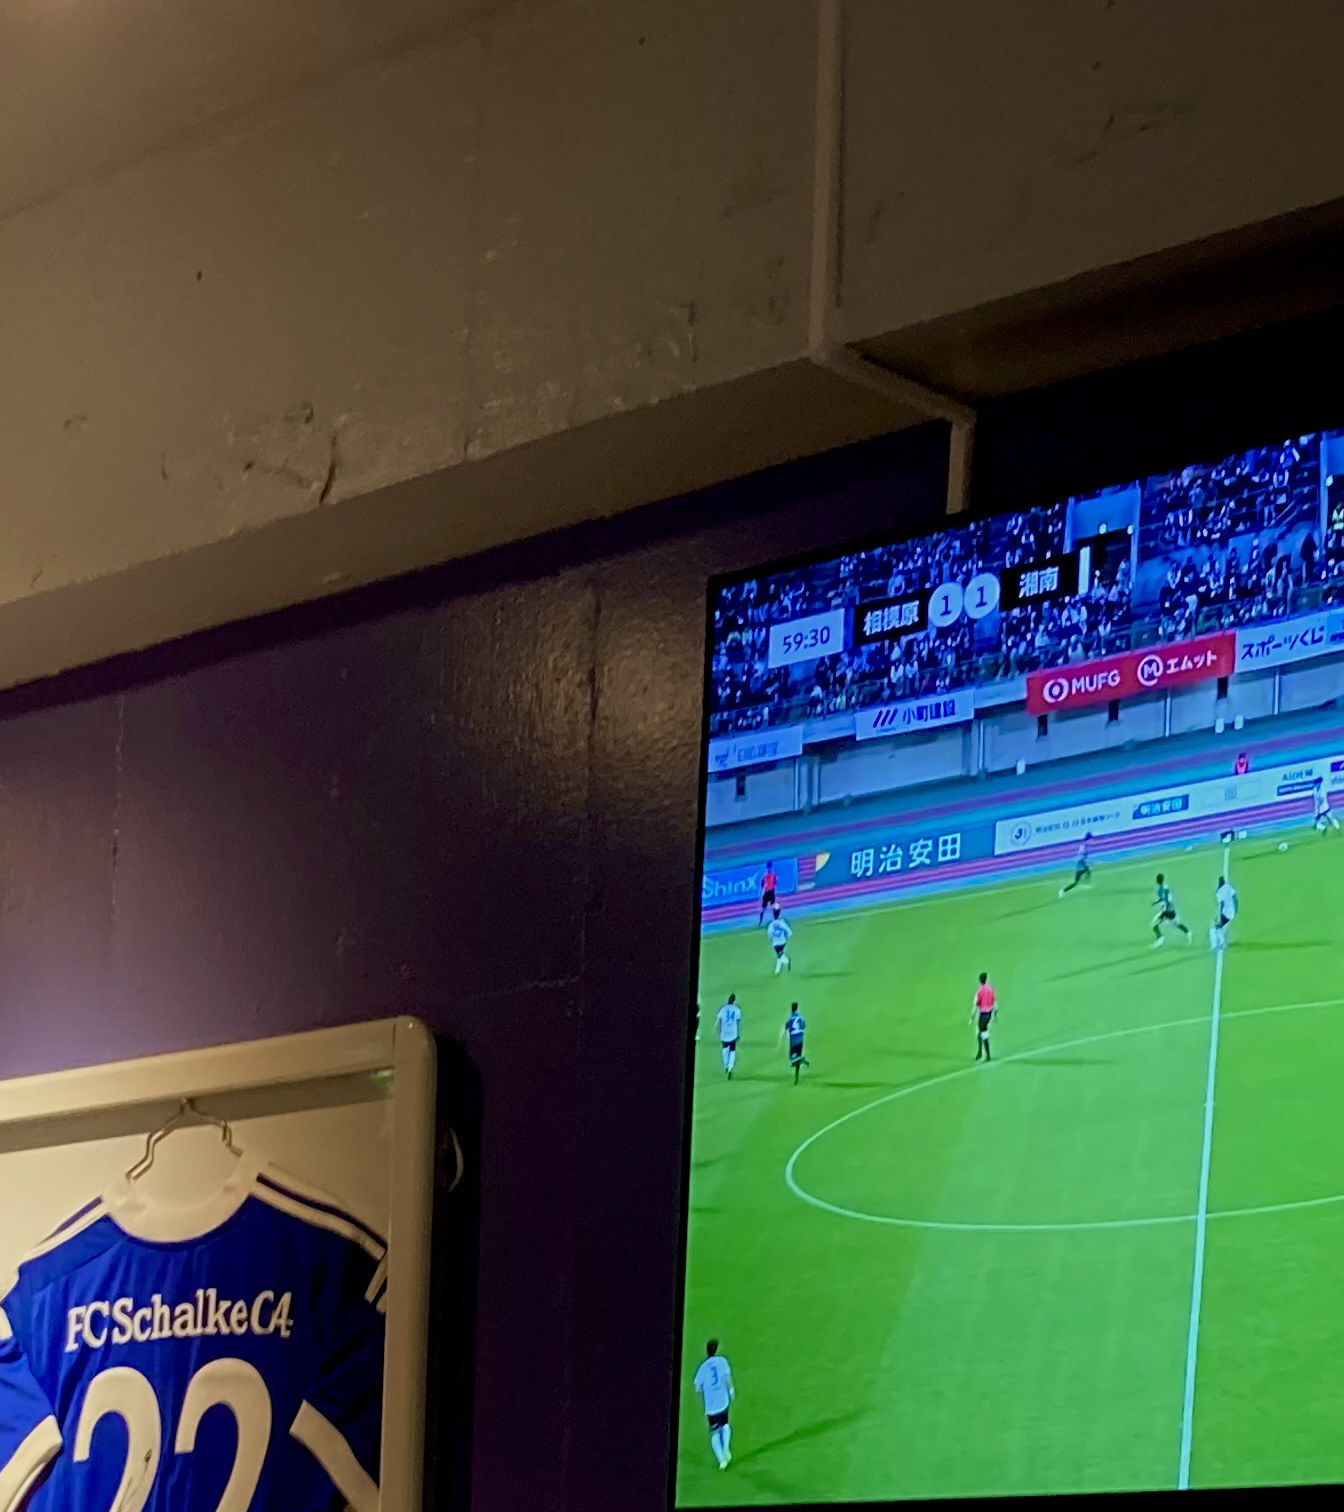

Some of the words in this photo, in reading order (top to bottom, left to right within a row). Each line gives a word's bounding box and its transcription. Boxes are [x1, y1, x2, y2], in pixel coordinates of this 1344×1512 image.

[974, 586, 988, 608] 1
[1018, 566, 1059, 598] 湘南
[863, 601, 920, 636] 相模原
[940, 595, 953, 617] 1
[782, 625, 831, 655] 59:30
[1240, 625, 1326, 661] スポーツくじ
[1165, 650, 1219, 675] エムット
[1070, 669, 1121, 694] MUFG
[850, 832, 962, 878] 明治安田
[64, 1301, 110, 1353] FC
[111, 1287, 249, 1345] Schalke
